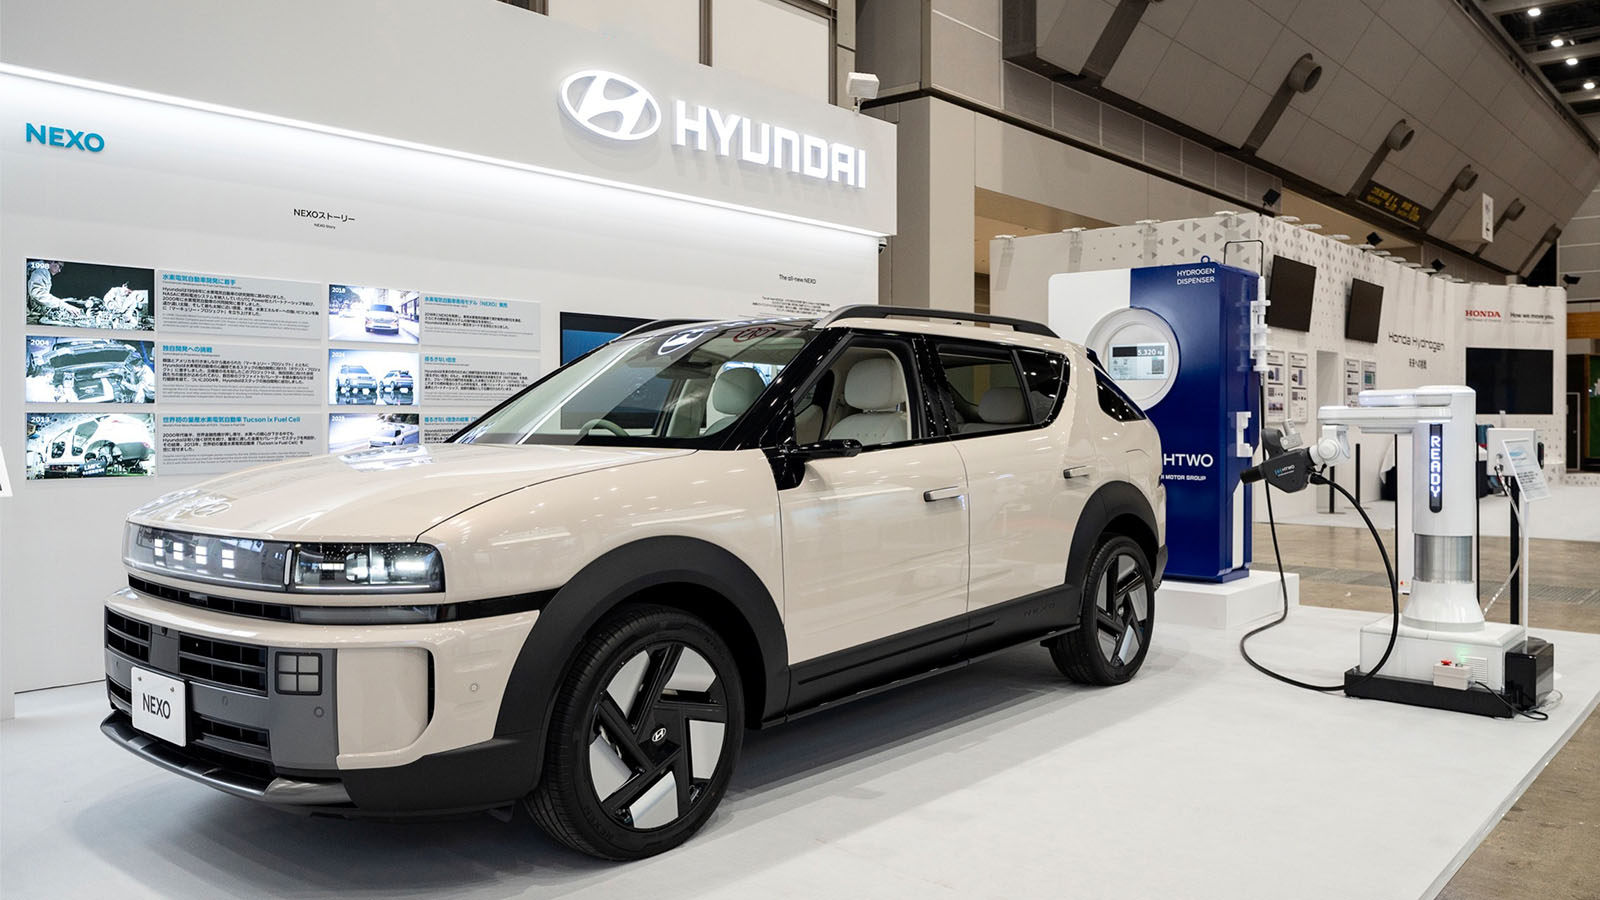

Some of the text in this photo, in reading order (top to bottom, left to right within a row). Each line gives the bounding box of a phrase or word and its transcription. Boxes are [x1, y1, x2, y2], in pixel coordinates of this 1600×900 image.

[25, 122, 105, 153] NEXO
[673, 99, 866, 189] HYUNDAI
[293, 208, 356, 223] NEXOストーリー
[30, 261, 50, 270] 1998
[1176, 267, 1215, 277] HYDROGEN
[779, 273, 787, 281] The
[1176, 276, 1215, 285] DISPENSER
[1465, 310, 1501, 318] HONDA
[1388, 331, 1411, 346] Honda
[1163, 453, 1214, 468] HTWO
[1430, 435, 1441, 498] READY
[142, 692, 171, 720] NEXO
